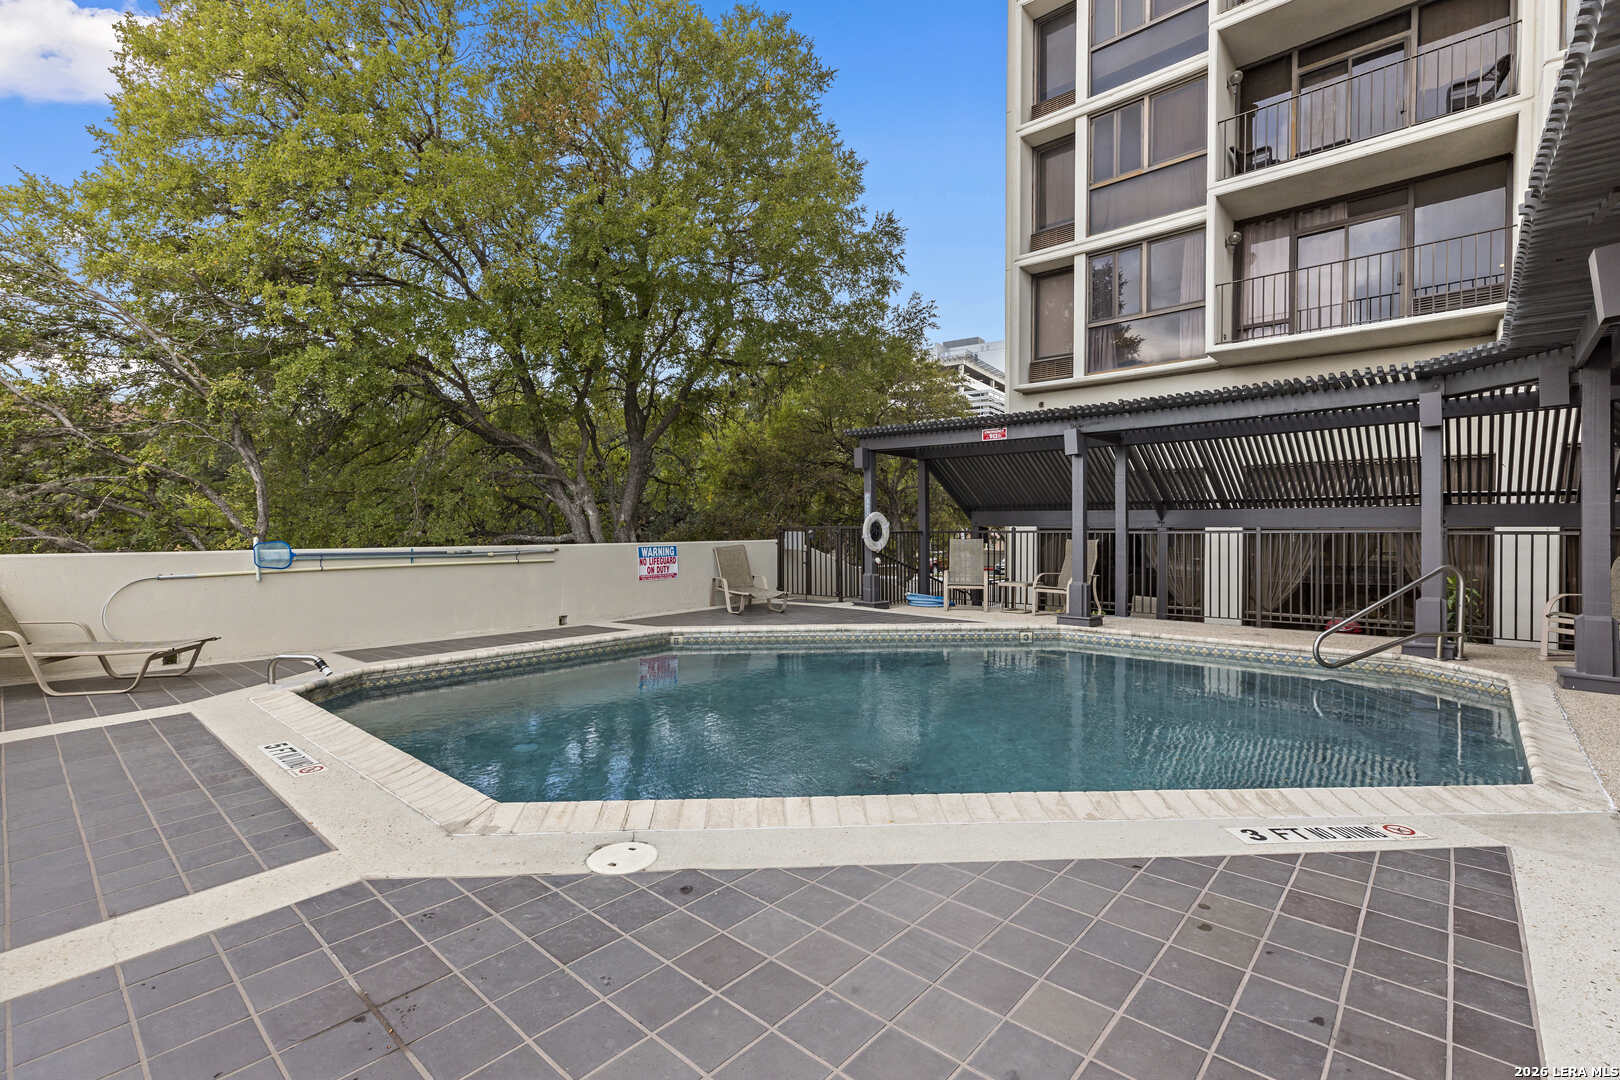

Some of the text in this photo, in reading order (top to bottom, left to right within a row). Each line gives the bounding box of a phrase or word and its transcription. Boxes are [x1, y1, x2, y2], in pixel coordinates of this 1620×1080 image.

[641, 547, 675, 557] WARNING
[640, 557, 677, 566] NO LIFEGUARD
[647, 565, 670, 574] ON DUTY
[1240, 826, 1388, 840] 3 FT NO DIVING
